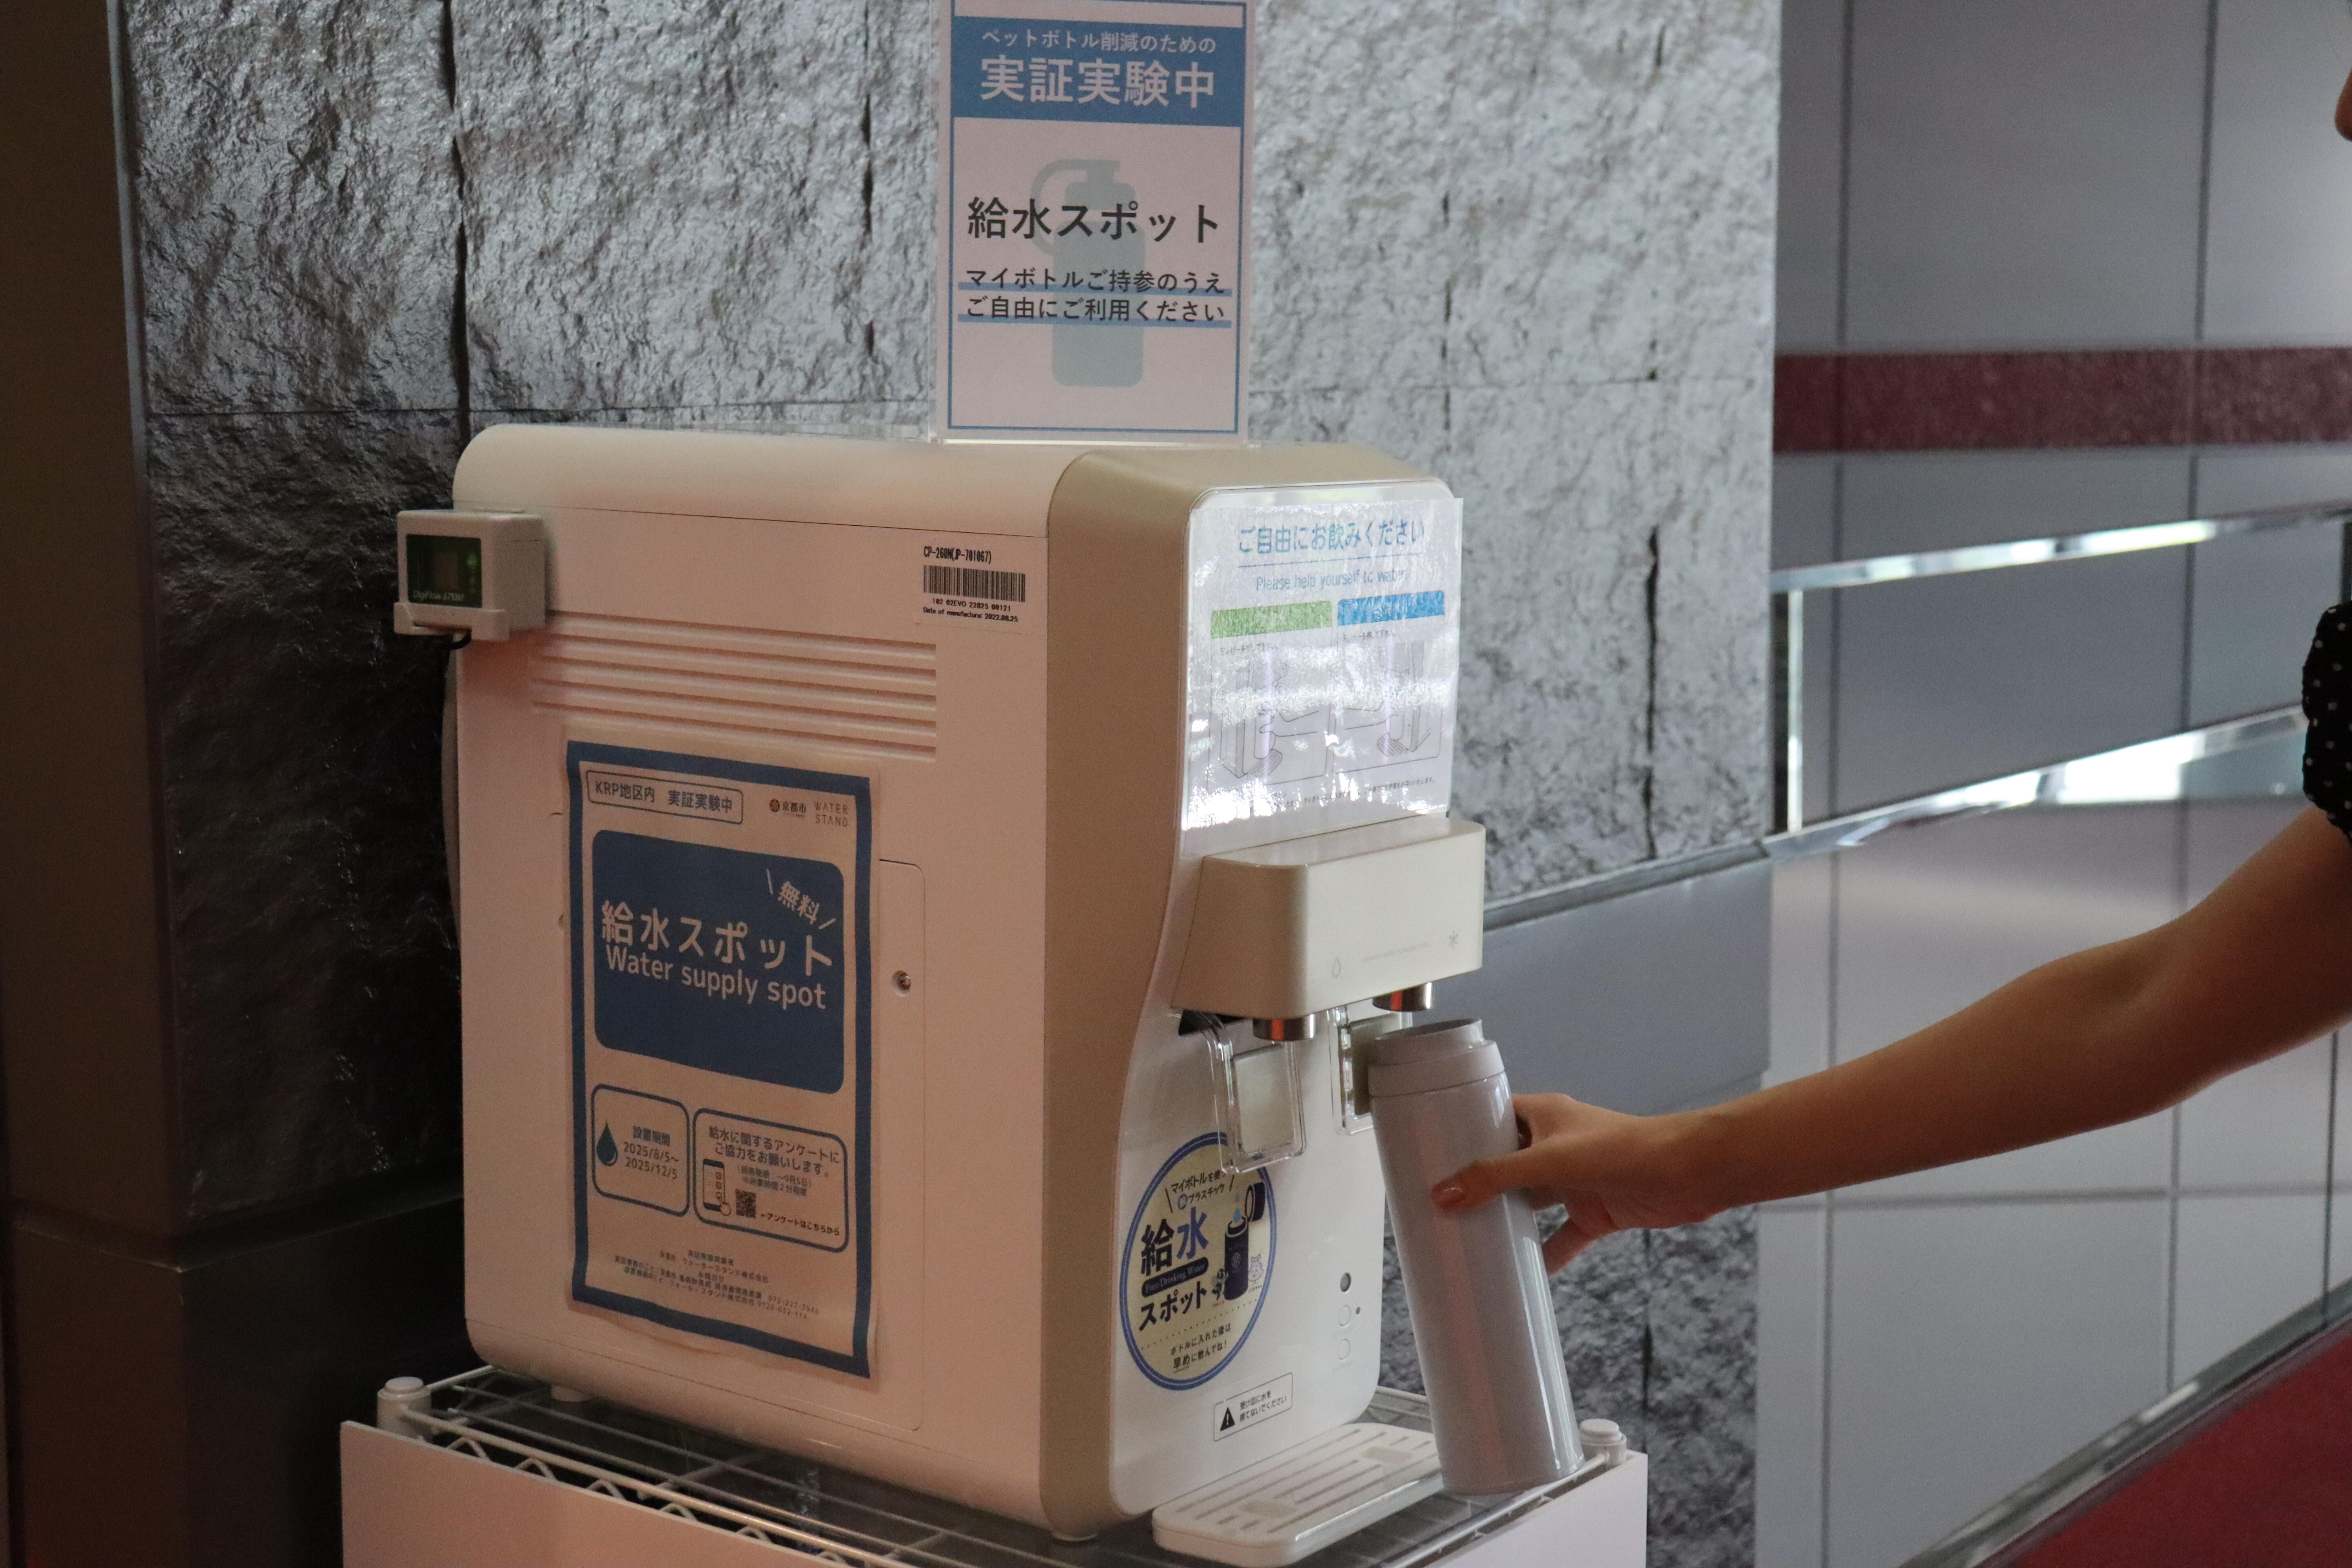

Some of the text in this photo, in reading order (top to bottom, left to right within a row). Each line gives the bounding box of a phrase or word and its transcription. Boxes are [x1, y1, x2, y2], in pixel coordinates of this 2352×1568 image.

[982, 29, 1216, 54] ペットボトル削減のための
[981, 54, 1214, 109] 実証実験中
[967, 196, 1218, 243] 給水スポット
[966, 268, 1224, 294] マイボトルご持参のうえ
[967, 296, 1224, 322] ご自由にご利用ください
[1240, 519, 1425, 554] ご自由にお飲みください
[1256, 576, 1291, 591] Please
[1295, 574, 1316, 590] help
[1320, 570, 1360, 592] yourself
[985, 613, 1018, 622] 2022.08.25
[595, 780, 733, 813] KRP地区内 実証実験中
[782, 800, 806, 814] 京都市
[814, 801, 848, 815] WATER
[815, 814, 849, 828] STAND
[777, 881, 820, 924] 無料
[602, 900, 832, 976] 給水スポット
[606, 944, 826, 1010] Water supply spot
[709, 1125, 840, 1163] 給水に関するアンケートに
[715, 1142, 829, 1178] ご協力をお願いします。
[626, 1157, 677, 1180] 2025/12/5
[1141, 1206, 1209, 1276] 給水
[1160, 1272, 1187, 1287] Drinking
[1187, 1263, 1205, 1276] Water
[1139, 1281, 1207, 1332] スポット
[1171, 1323, 1231, 1356] ボトルに入れた後は
[1240, 1396, 1287, 1422] 捨てないでください
